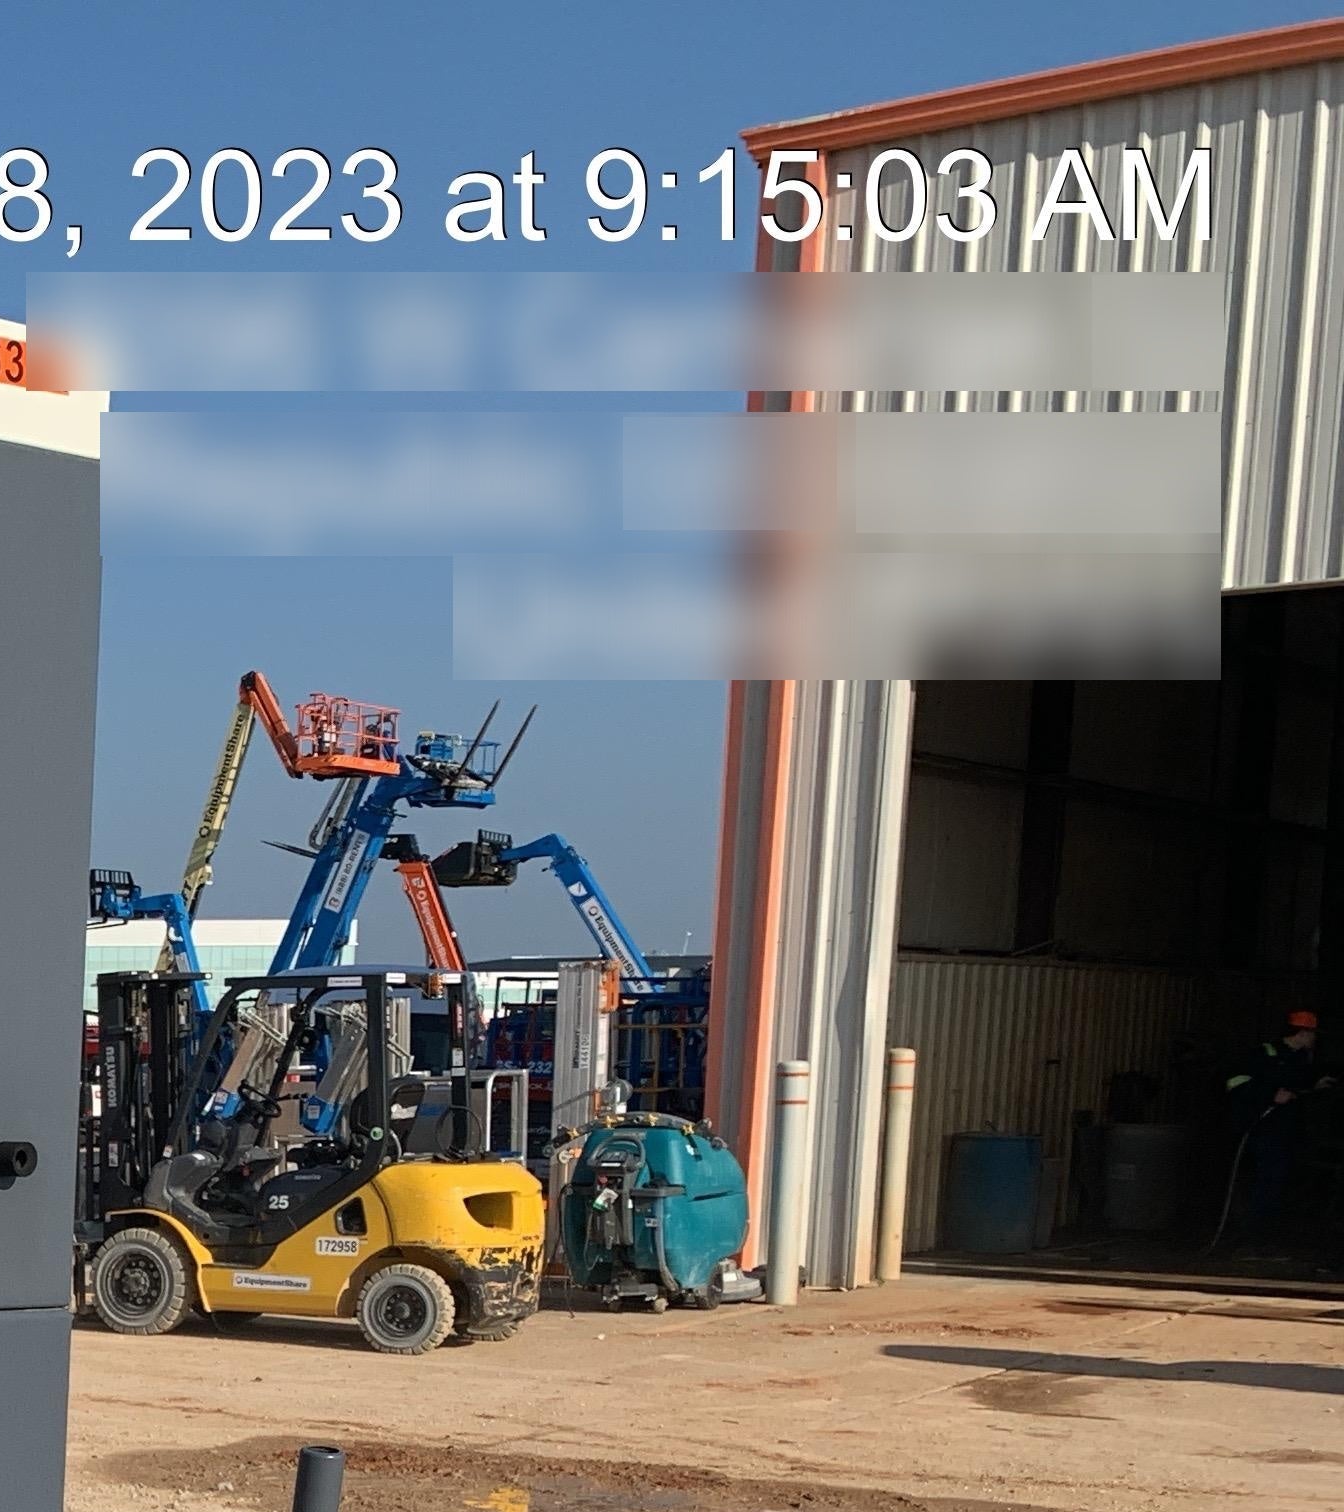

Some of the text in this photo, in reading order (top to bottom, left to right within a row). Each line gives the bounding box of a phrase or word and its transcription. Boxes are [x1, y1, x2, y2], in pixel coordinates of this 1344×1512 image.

[202, 713, 245, 825] EquipmentShare
[105, 1045, 118, 1108] KOMATSU
[268, 1194, 290, 1210] 25
[317, 1239, 358, 1254] 172958
[243, 1276, 308, 1289] EquipmentShare
